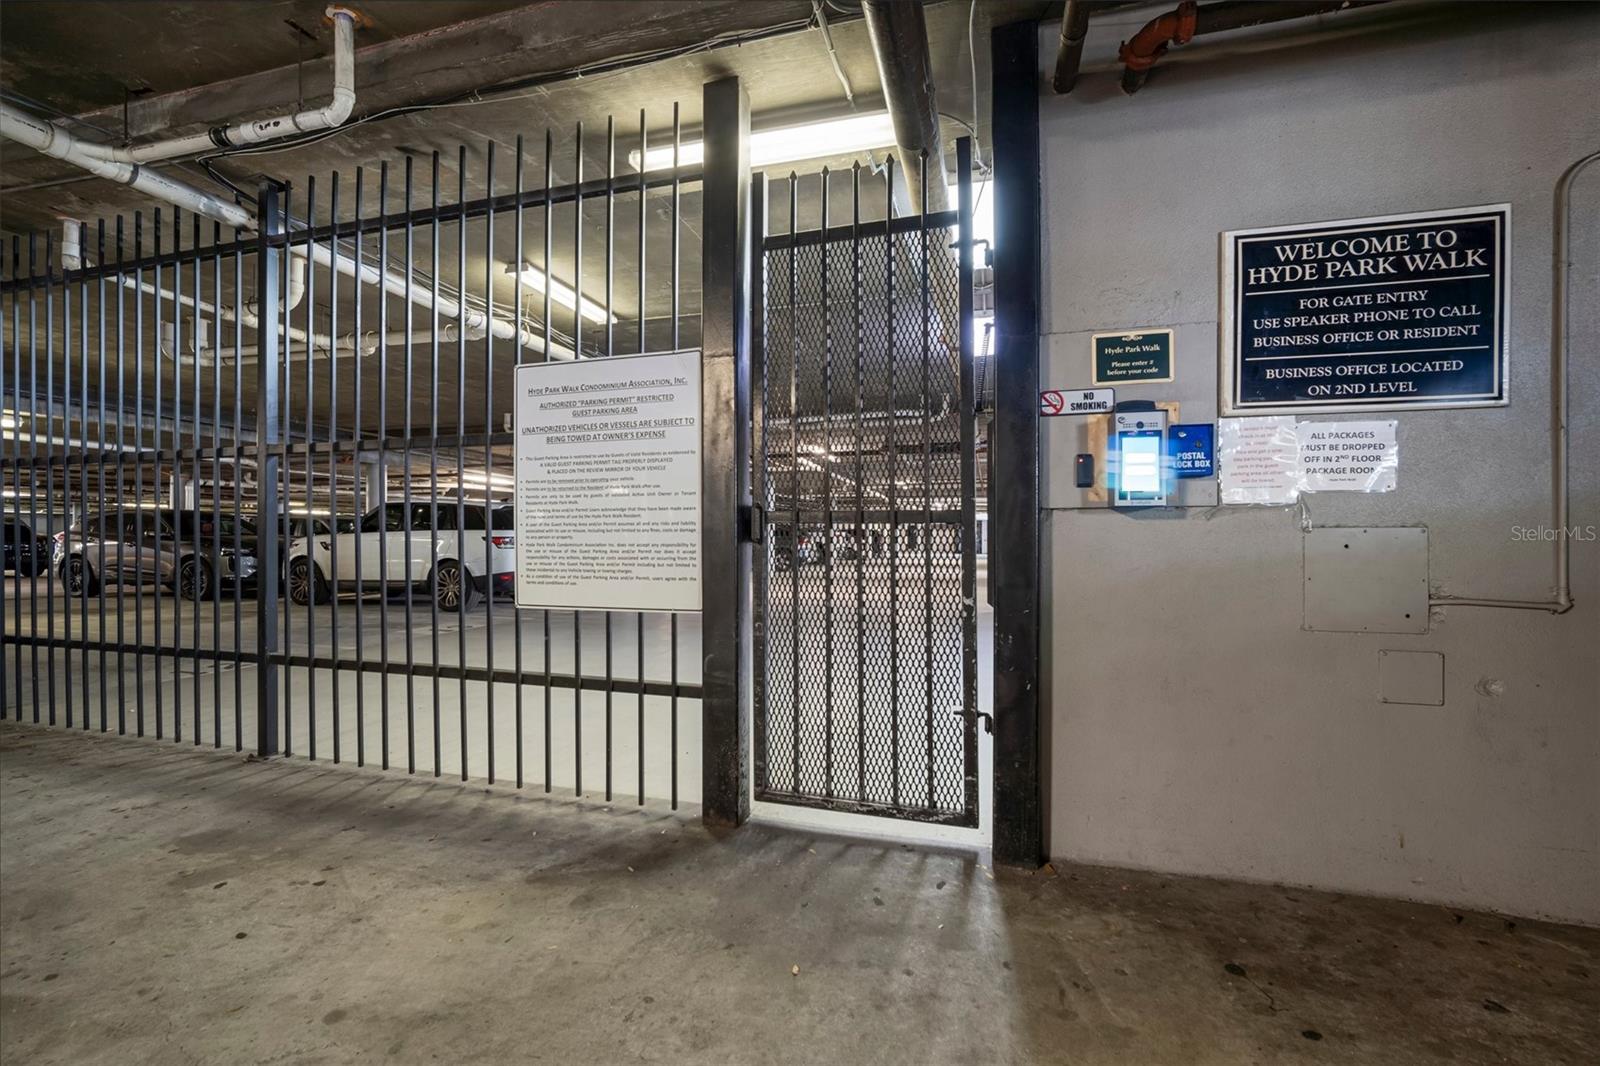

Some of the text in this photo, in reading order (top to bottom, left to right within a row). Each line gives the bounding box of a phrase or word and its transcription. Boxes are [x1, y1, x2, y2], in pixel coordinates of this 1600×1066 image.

[1274, 230, 1457, 262] WELCOME TO
[1248, 248, 1487, 285] HYDE PARK WALK
[1300, 290, 1429, 310] FOR GATE ENTRY
[1253, 304, 1480, 330] USE SPEAKER PHONE TO CALL
[1254, 325, 1480, 348] BUSINESS OFFICE OR RESIDENT
[1105, 347, 1124, 355] Hyde
[1142, 344, 1160, 352] Walk
[1266, 360, 1464, 379] BUSINESS OFFICE LOCATED
[1308, 381, 1417, 396] ON 2ND LEVEL
[1083, 392, 1094, 400] NO
[621, 406, 638, 414] AREA
[1070, 401, 1108, 411] SMOKING
[522, 425, 567, 434] UNATHORIZED
[568, 423, 597, 432] VEHICLES
[599, 422, 608, 430] OR
[610, 421, 637, 429] VESSELS
[654, 418, 683, 426] SUBJECT
[685, 417, 694, 425] TO
[602, 432, 634, 440] OWNER'S
[636, 430, 665, 439] EXPENSE
[1328, 431, 1375, 439] PACKAGES
[1342, 443, 1385, 451] DROPPED
[1177, 452, 1206, 460] POSTAL
[1194, 460, 1211, 468] BOX
